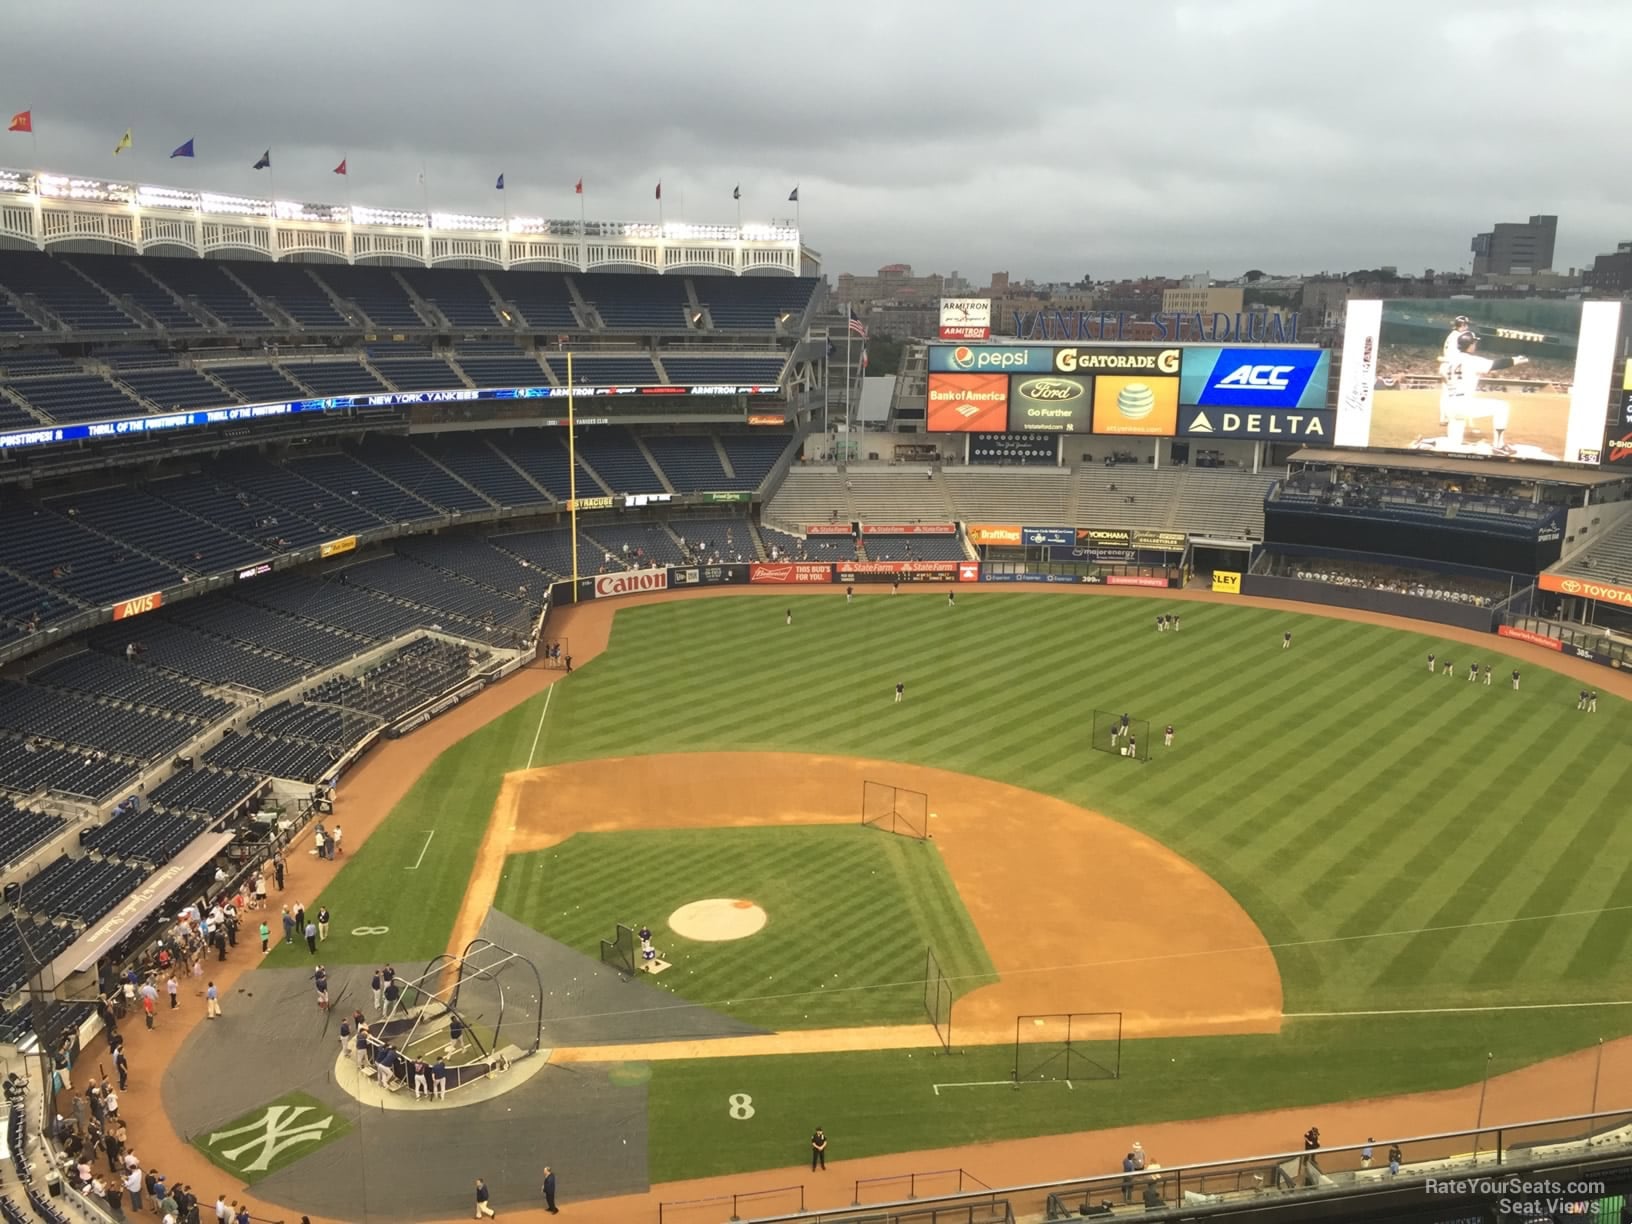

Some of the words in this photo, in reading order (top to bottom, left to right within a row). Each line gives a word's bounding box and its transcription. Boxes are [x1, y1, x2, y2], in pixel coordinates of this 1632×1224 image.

[943, 302, 989, 310] ARMITRON
[1013, 310, 1133, 341] YANKEE
[1151, 311, 1299, 342] STADIUM
[978, 350, 1028, 368] pepsi
[1079, 355, 1156, 369] GATORADE
[1220, 364, 1296, 386] ACC
[549, 387, 595, 397] ARMTRON
[691, 386, 736, 395] ARMITRON
[930, 390, 955, 401] Bank
[955, 390, 966, 401] of
[966, 390, 1005, 401] America
[1031, 381, 1071, 399] Ford
[369, 395, 393, 406] NEW
[395, 393, 423, 404] YORK
[427, 391, 479, 402] YANKEES
[207, 411, 228, 422] THRILL
[230, 410, 239, 419] OF
[239, 408, 251, 418] THE
[1028, 409, 1040, 417] Go
[1041, 408, 1072, 417] Further
[88, 424, 116, 436] THRILL
[117, 423, 129, 433] OF
[129, 422, 143, 431] THE
[1223, 412, 1324, 435] DELTA
[574, 497, 613, 508] SYRACUSE
[981, 530, 1020, 540] DraftKings
[1088, 531, 1129, 540] YOKOHAMA
[596, 572, 666, 595] Canon
[1583, 584, 1632, 602] TOYOTA
[122, 596, 153, 618] AVIS
[728, 1093, 755, 1120] 8
